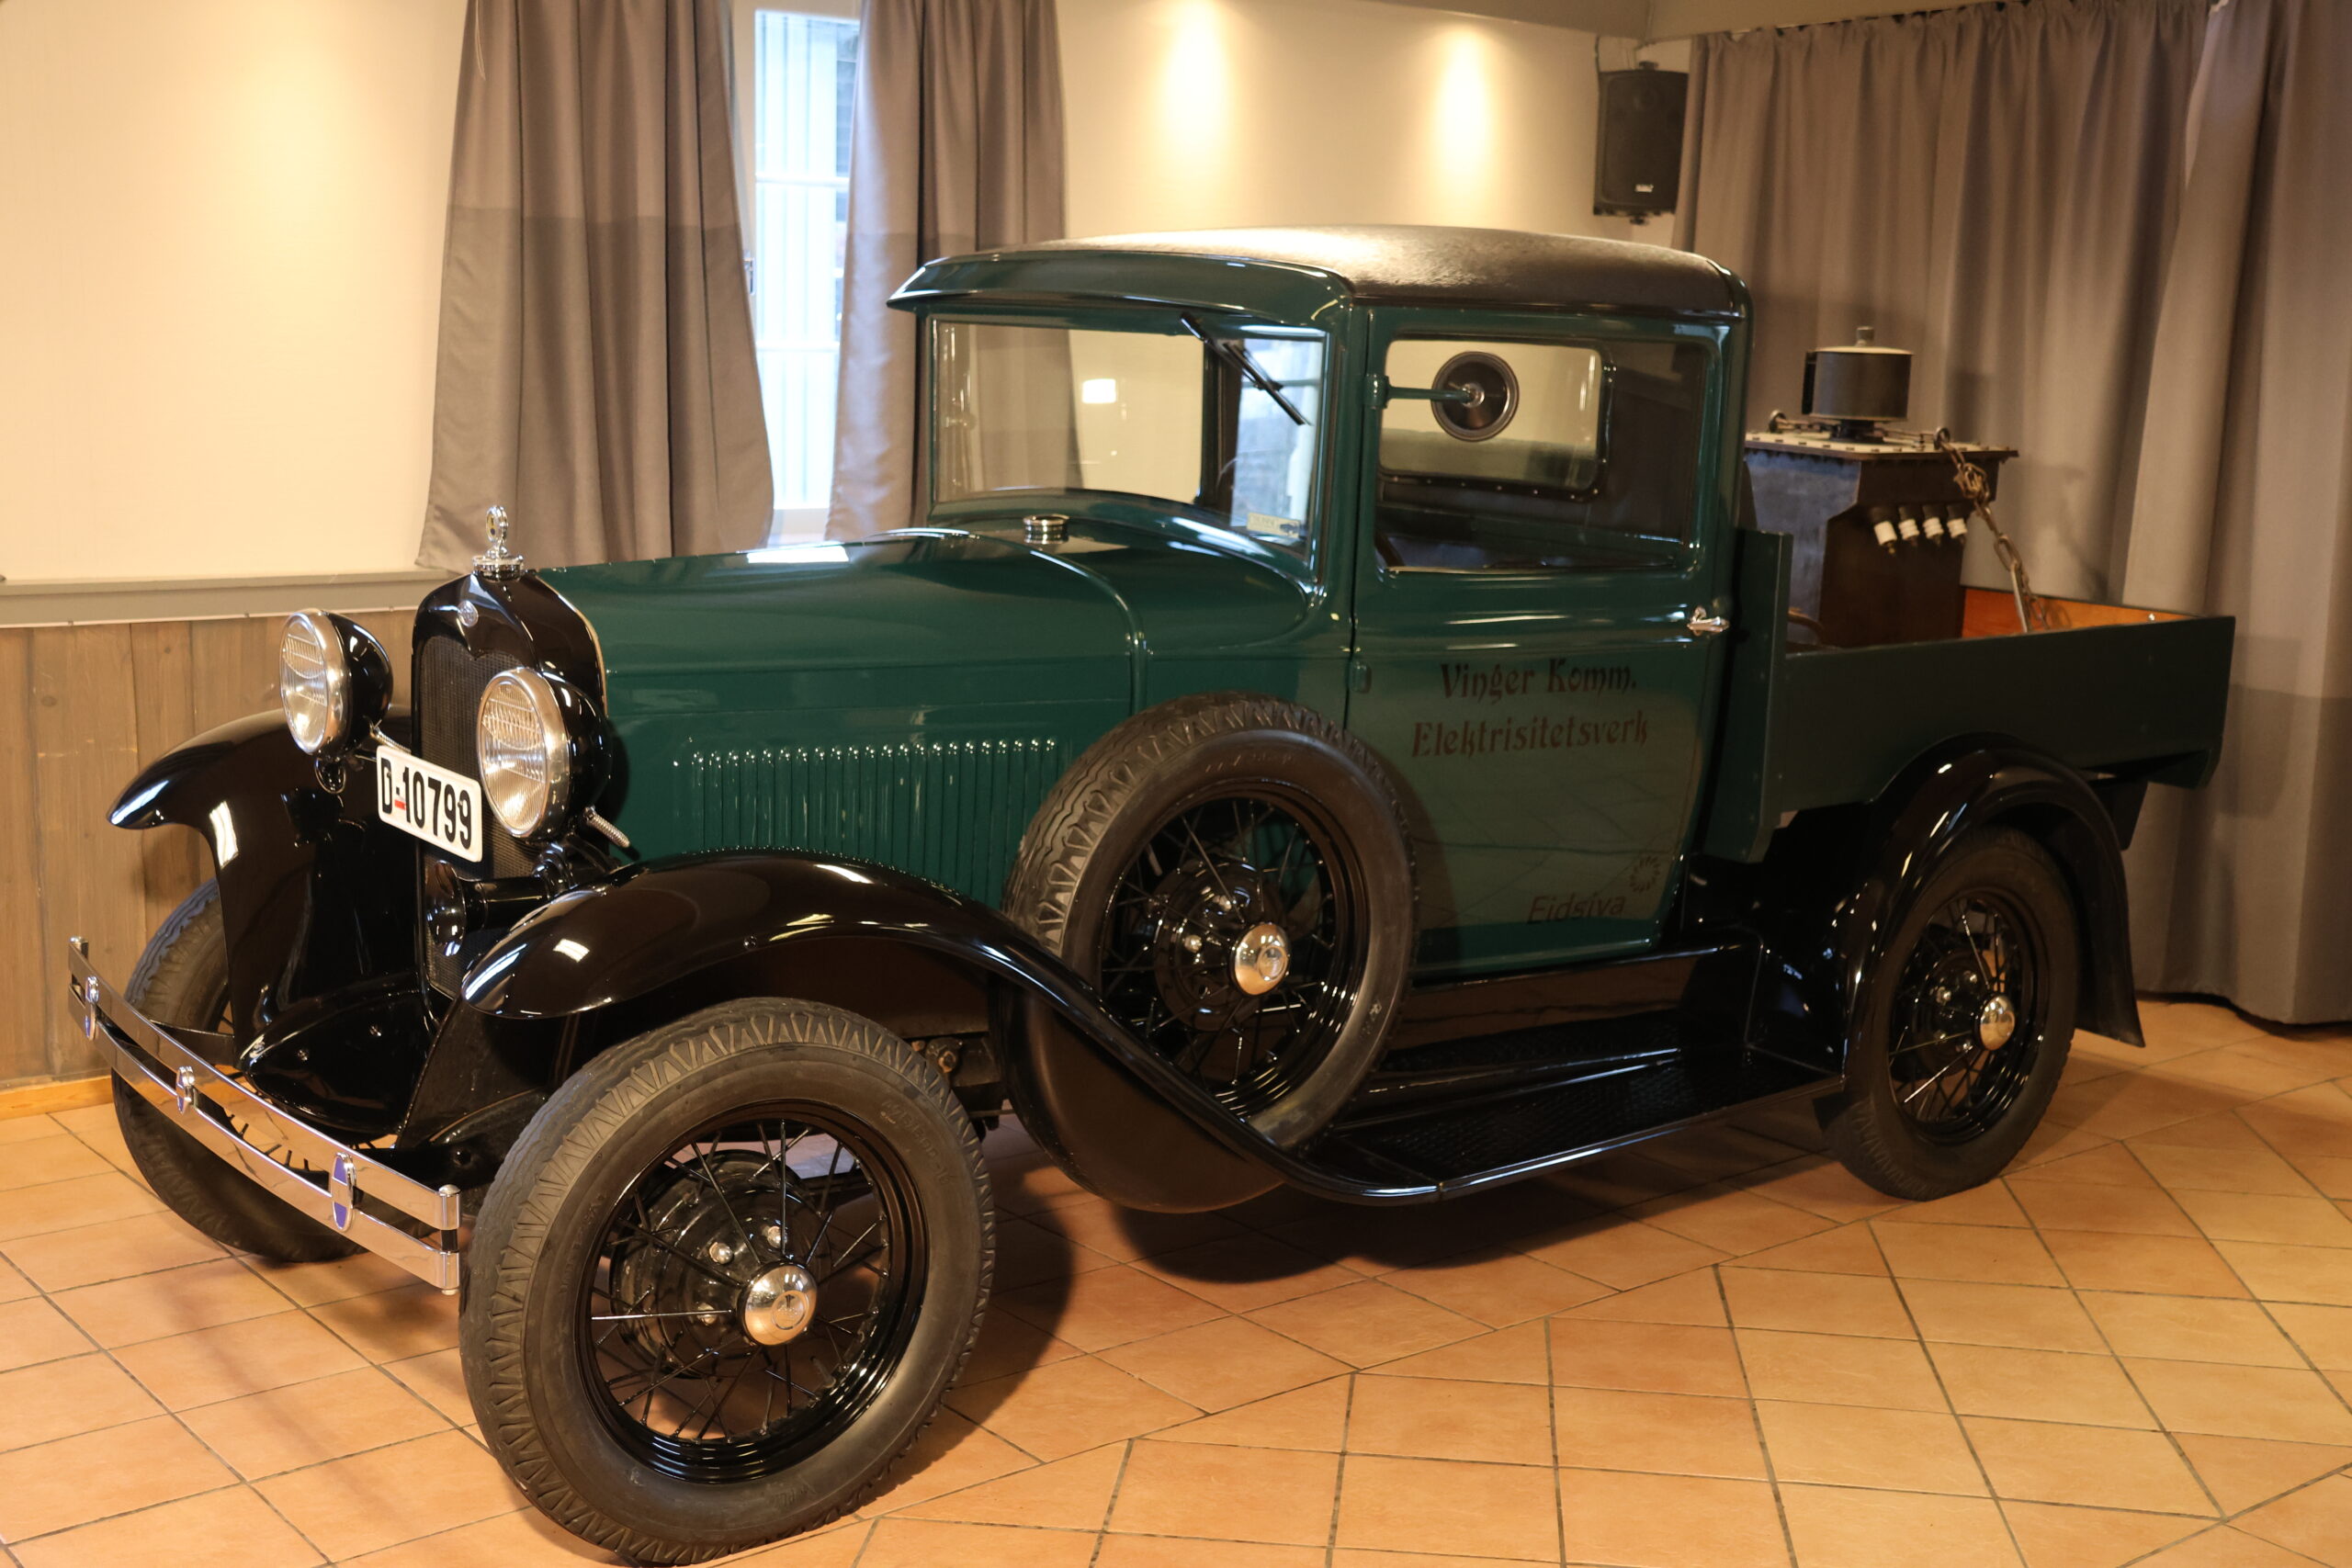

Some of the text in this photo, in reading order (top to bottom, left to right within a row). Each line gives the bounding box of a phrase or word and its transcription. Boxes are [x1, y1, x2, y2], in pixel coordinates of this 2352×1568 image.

[1440, 657, 1637, 705] Vinger Komm.
[1411, 709, 1648, 758] Elektrisitetsverk
[380, 757, 472, 850] D-10799
[1526, 892, 1627, 924] Eidsiva
